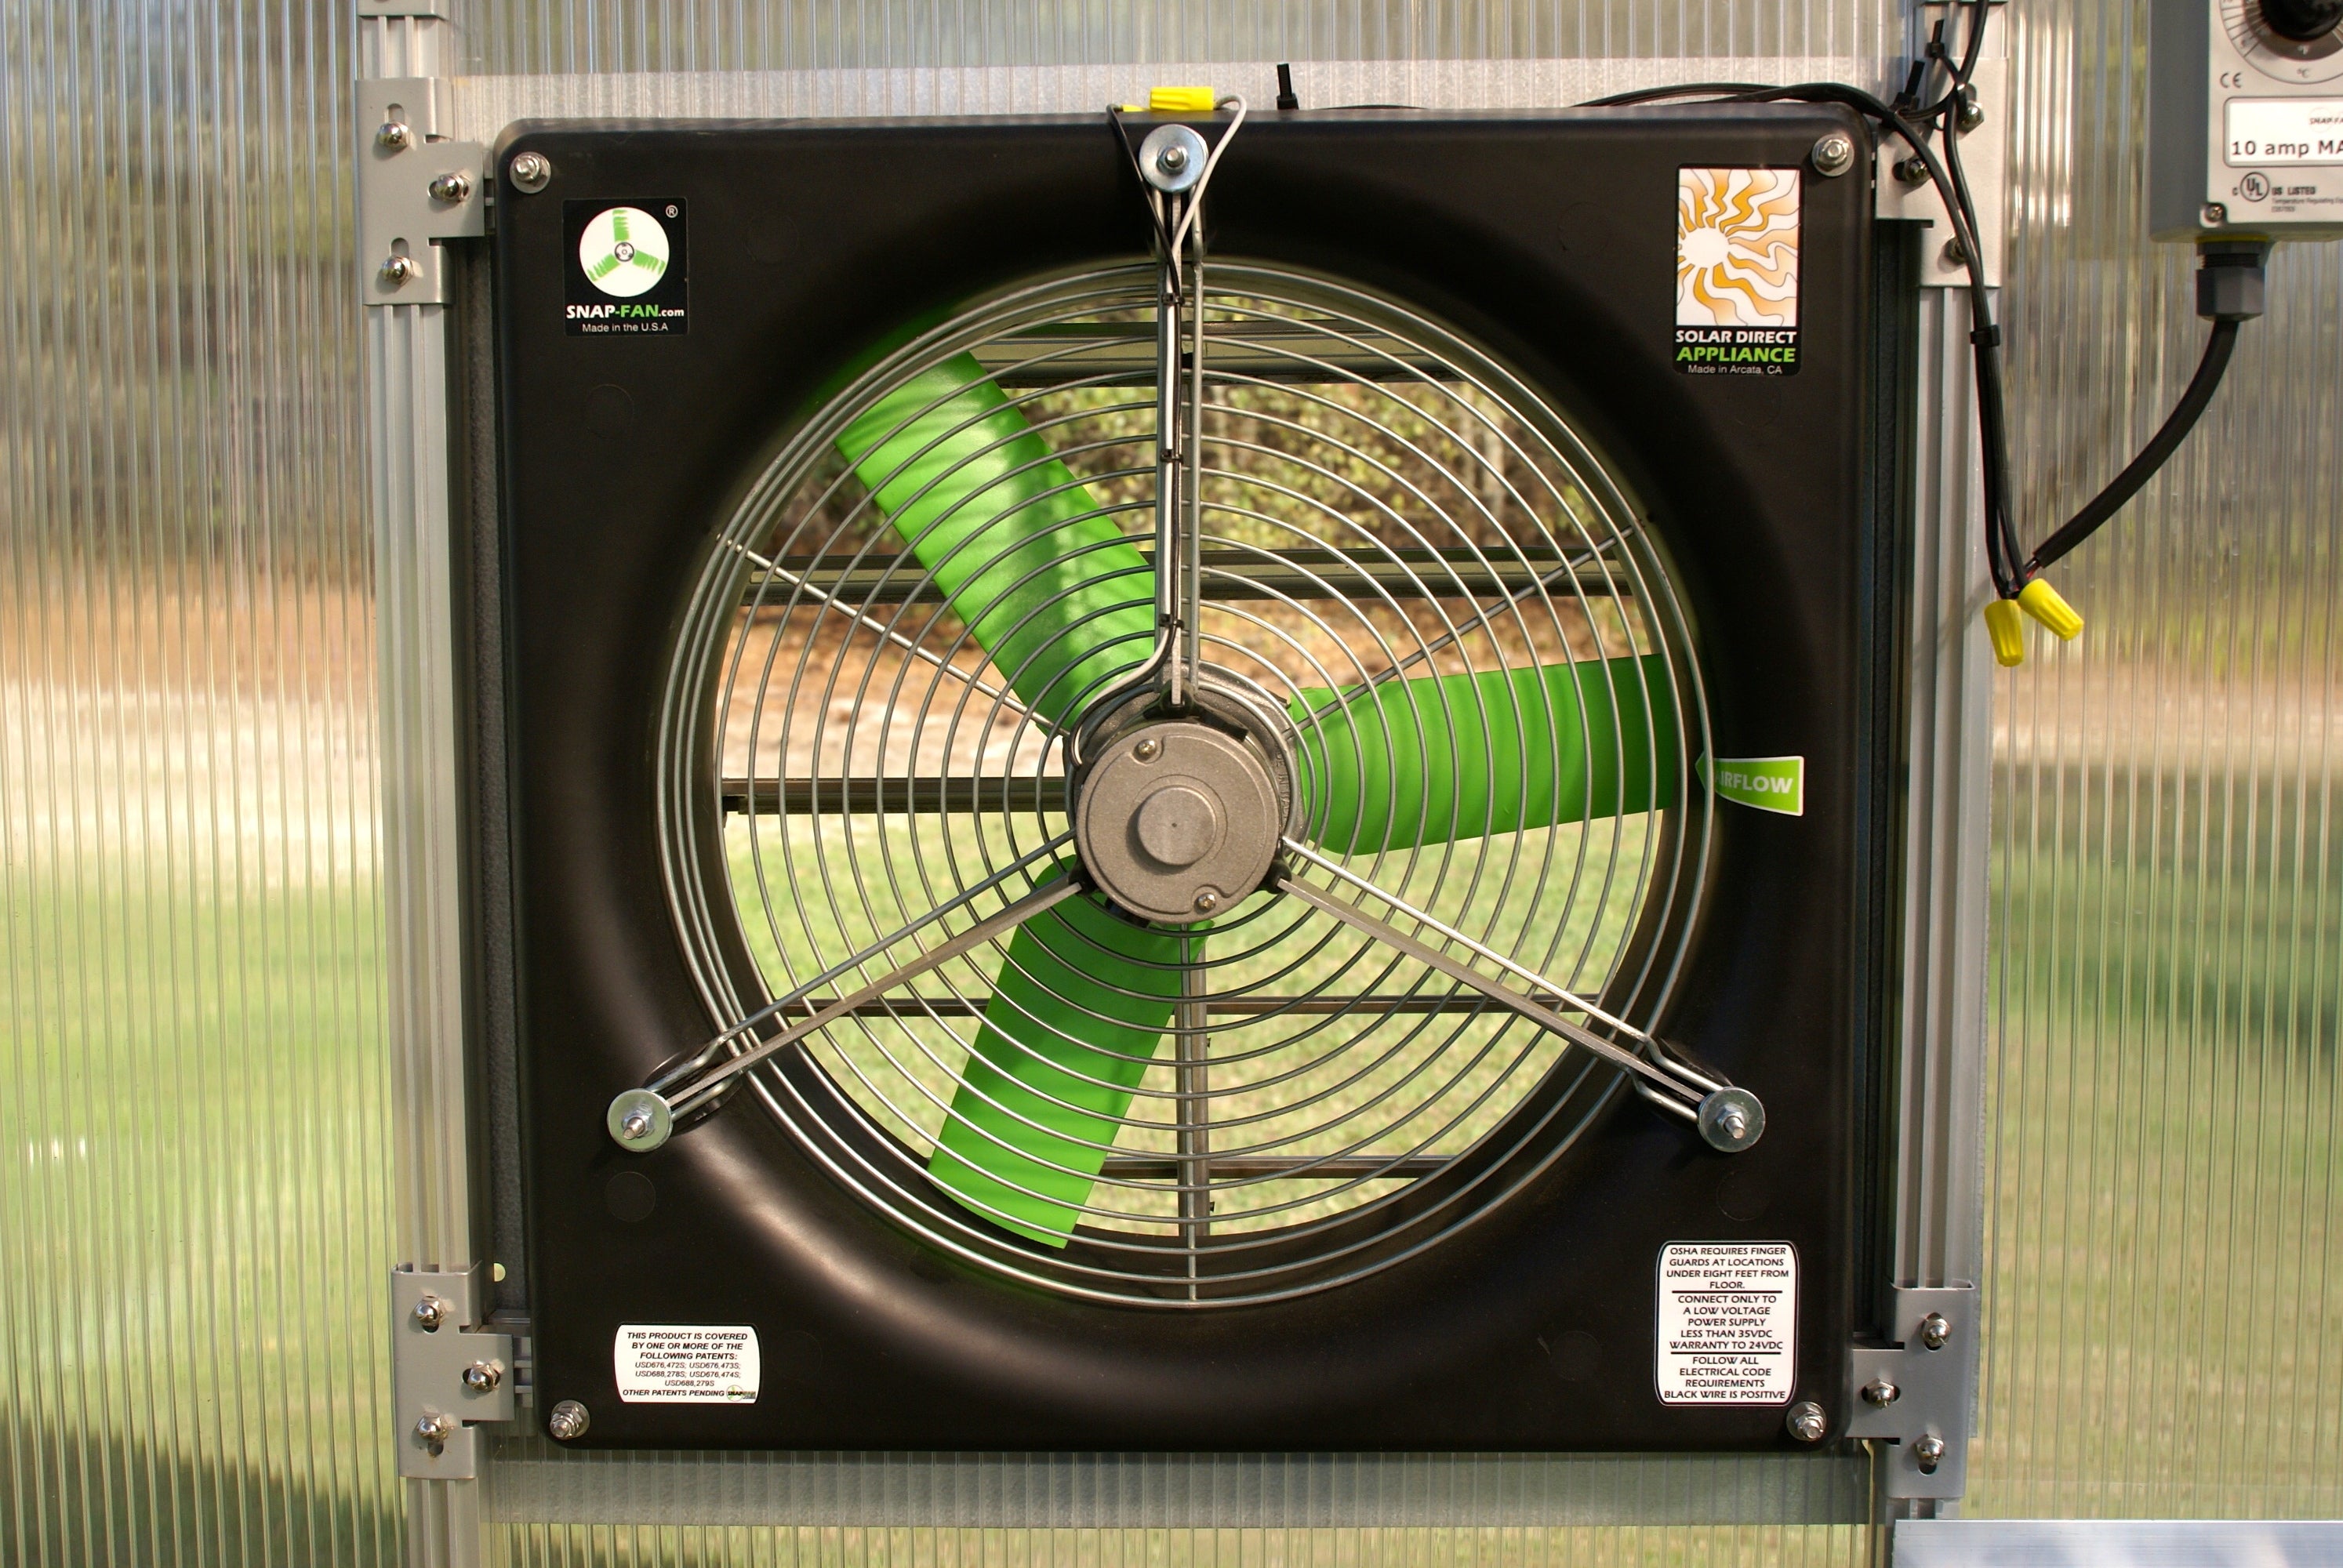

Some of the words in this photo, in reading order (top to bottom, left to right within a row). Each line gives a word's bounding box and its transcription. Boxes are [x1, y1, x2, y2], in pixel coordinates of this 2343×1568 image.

[2232, 141, 2256, 155] 10
[2265, 143, 2308, 158] amp
[566, 304, 684, 318] SNAP-FAN.com
[583, 324, 609, 332] Made
[1676, 330, 1732, 343] SOLAR
[1736, 331, 1797, 343] DIRECT
[1676, 347, 1796, 362] APPLIANCE
[1730, 365, 1764, 374] Arcata,
[1767, 365, 1782, 374] CA
